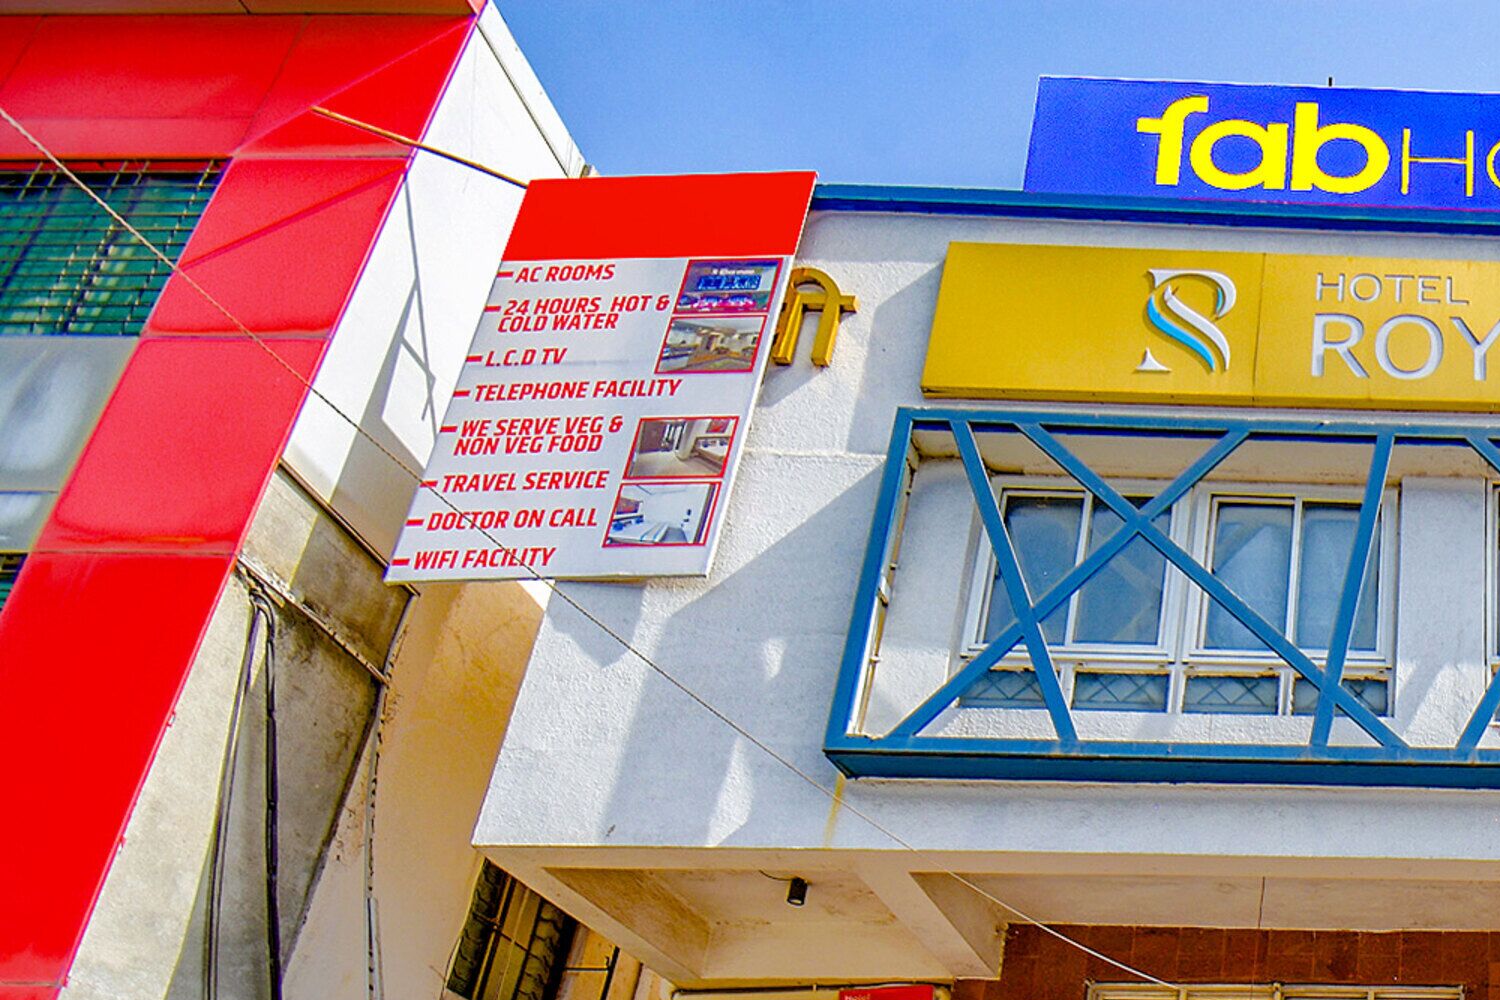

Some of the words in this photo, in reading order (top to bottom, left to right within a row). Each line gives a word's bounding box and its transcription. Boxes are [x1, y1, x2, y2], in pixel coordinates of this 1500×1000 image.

[515, 265, 544, 282] AC
[545, 264, 615, 282] ROOMS
[1315, 272, 1470, 307] HOTEL
[503, 299, 529, 315] 24
[532, 297, 600, 314] HOURS
[611, 297, 654, 312] HOT
[655, 295, 670, 311] &
[498, 315, 548, 332] COLD
[551, 313, 619, 331] WATER
[485, 349, 532, 366] L.C.D
[539, 348, 567, 365] TV
[475, 382, 590, 402] TELEPHONE
[593, 379, 683, 398] FACILITY
[461, 419, 494, 437] WE
[494, 418, 562, 436] SERVE
[565, 417, 605, 434] VEG
[608, 416, 622, 432] &
[454, 438, 499, 456] NON
[505, 436, 542, 454] VEG
[548, 435, 602, 453] FOOD
[443, 473, 516, 493] TRAVEL
[522, 471, 609, 490] SERVICE
[427, 511, 508, 531] DOCTOR
[514, 510, 544, 529] ON
[548, 509, 598, 527] CALL
[414, 550, 457, 570] WIFI
[461, 547, 555, 568] FACILITY
